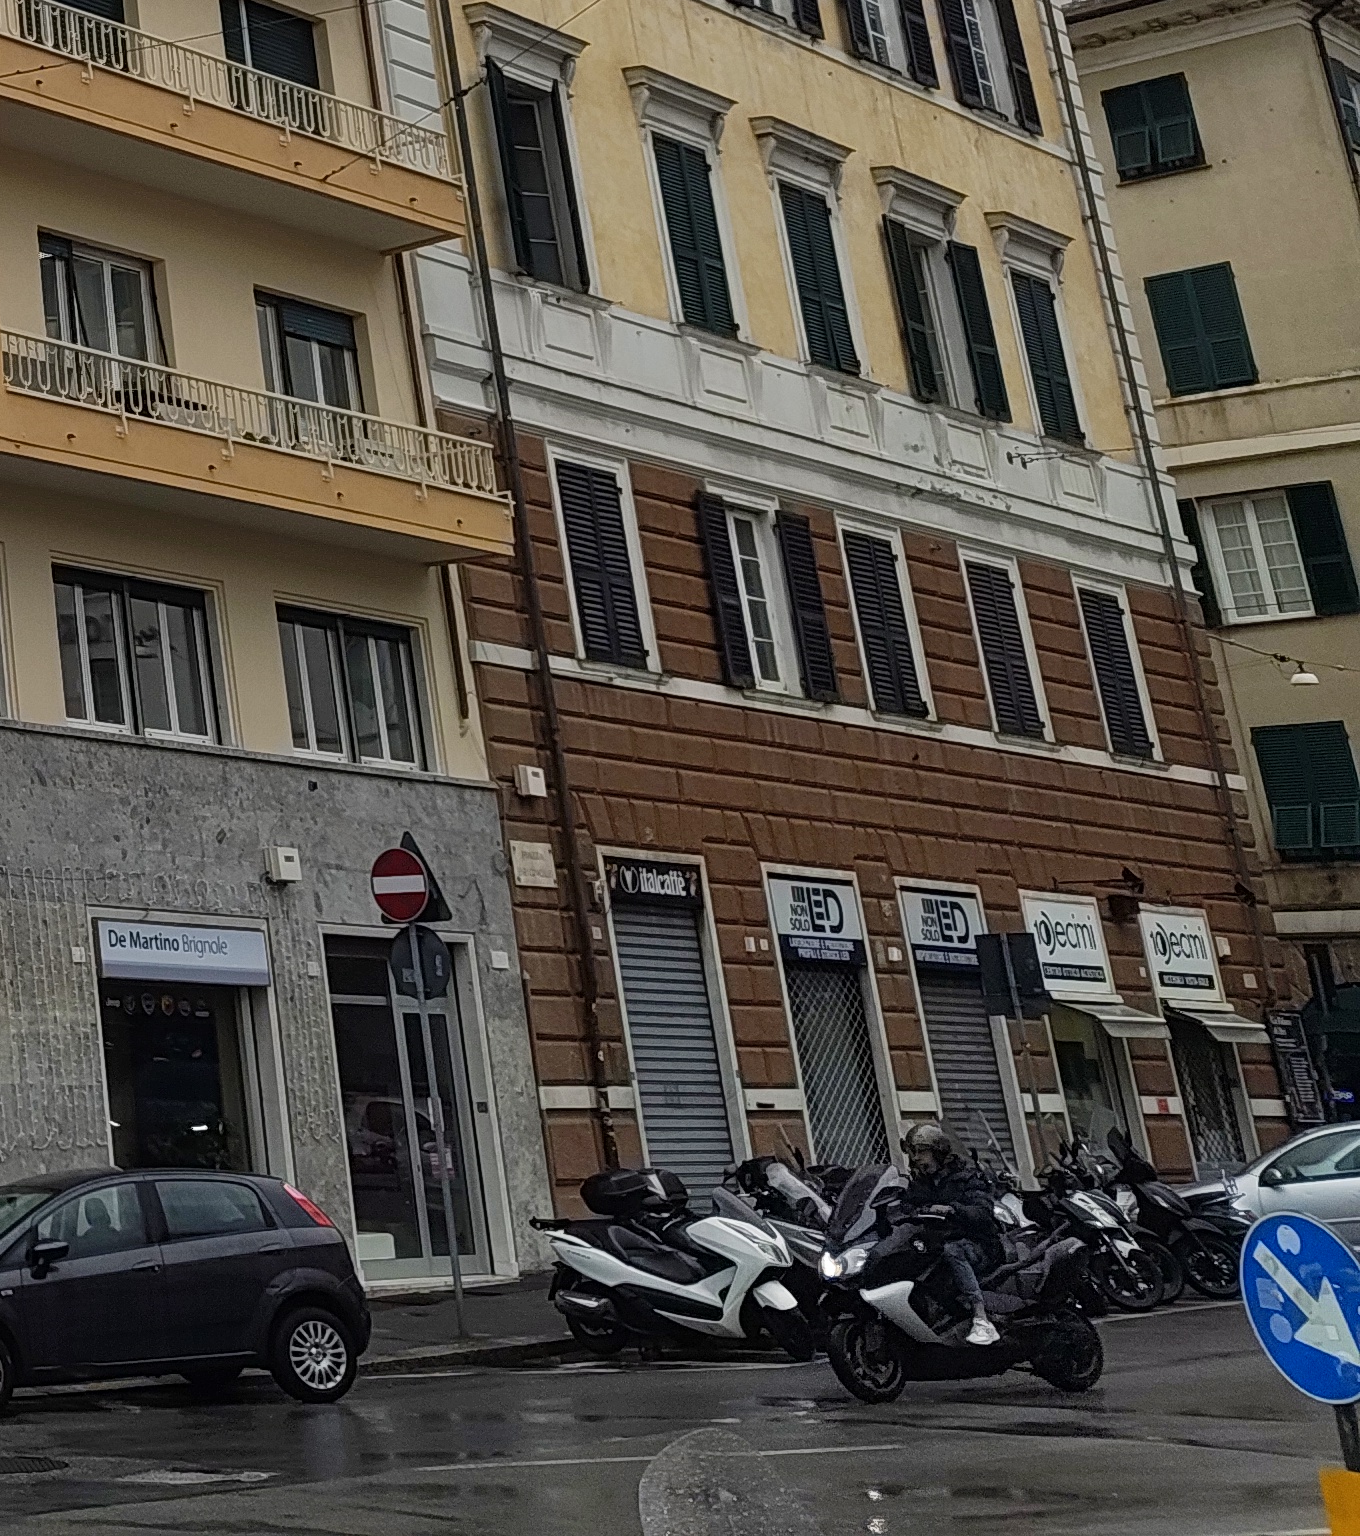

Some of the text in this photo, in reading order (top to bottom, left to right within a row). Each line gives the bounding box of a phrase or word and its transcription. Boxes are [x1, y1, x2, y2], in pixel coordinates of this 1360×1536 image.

[790, 903, 808, 917] NON
[790, 917, 810, 932] SOLO
[921, 914, 938, 928] NON
[921, 927, 940, 942] SOLO
[108, 929, 228, 958] De Martino Brignole
